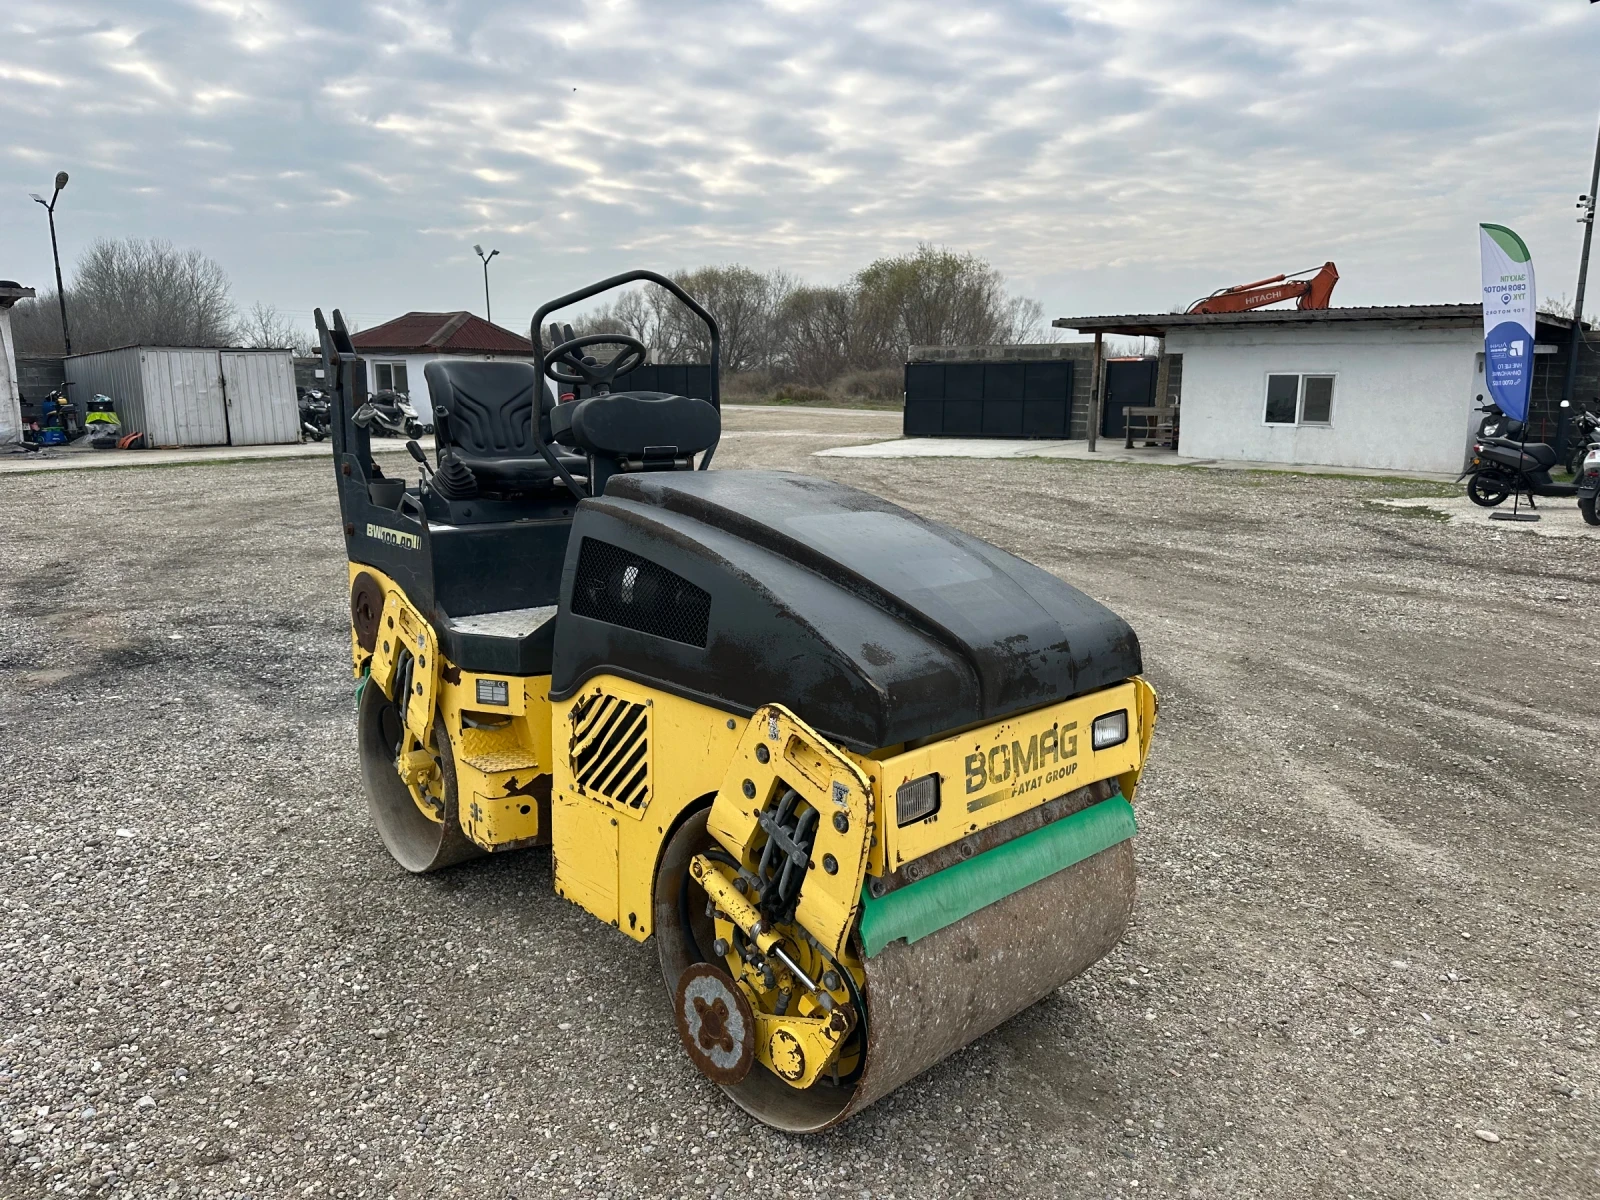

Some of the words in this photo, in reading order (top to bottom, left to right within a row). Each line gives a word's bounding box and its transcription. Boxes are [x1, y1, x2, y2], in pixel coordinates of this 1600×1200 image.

[1245, 291, 1282, 304] HITACHI
[965, 721, 1078, 794] BOMAG
[1045, 762, 1078, 784] GROUP
